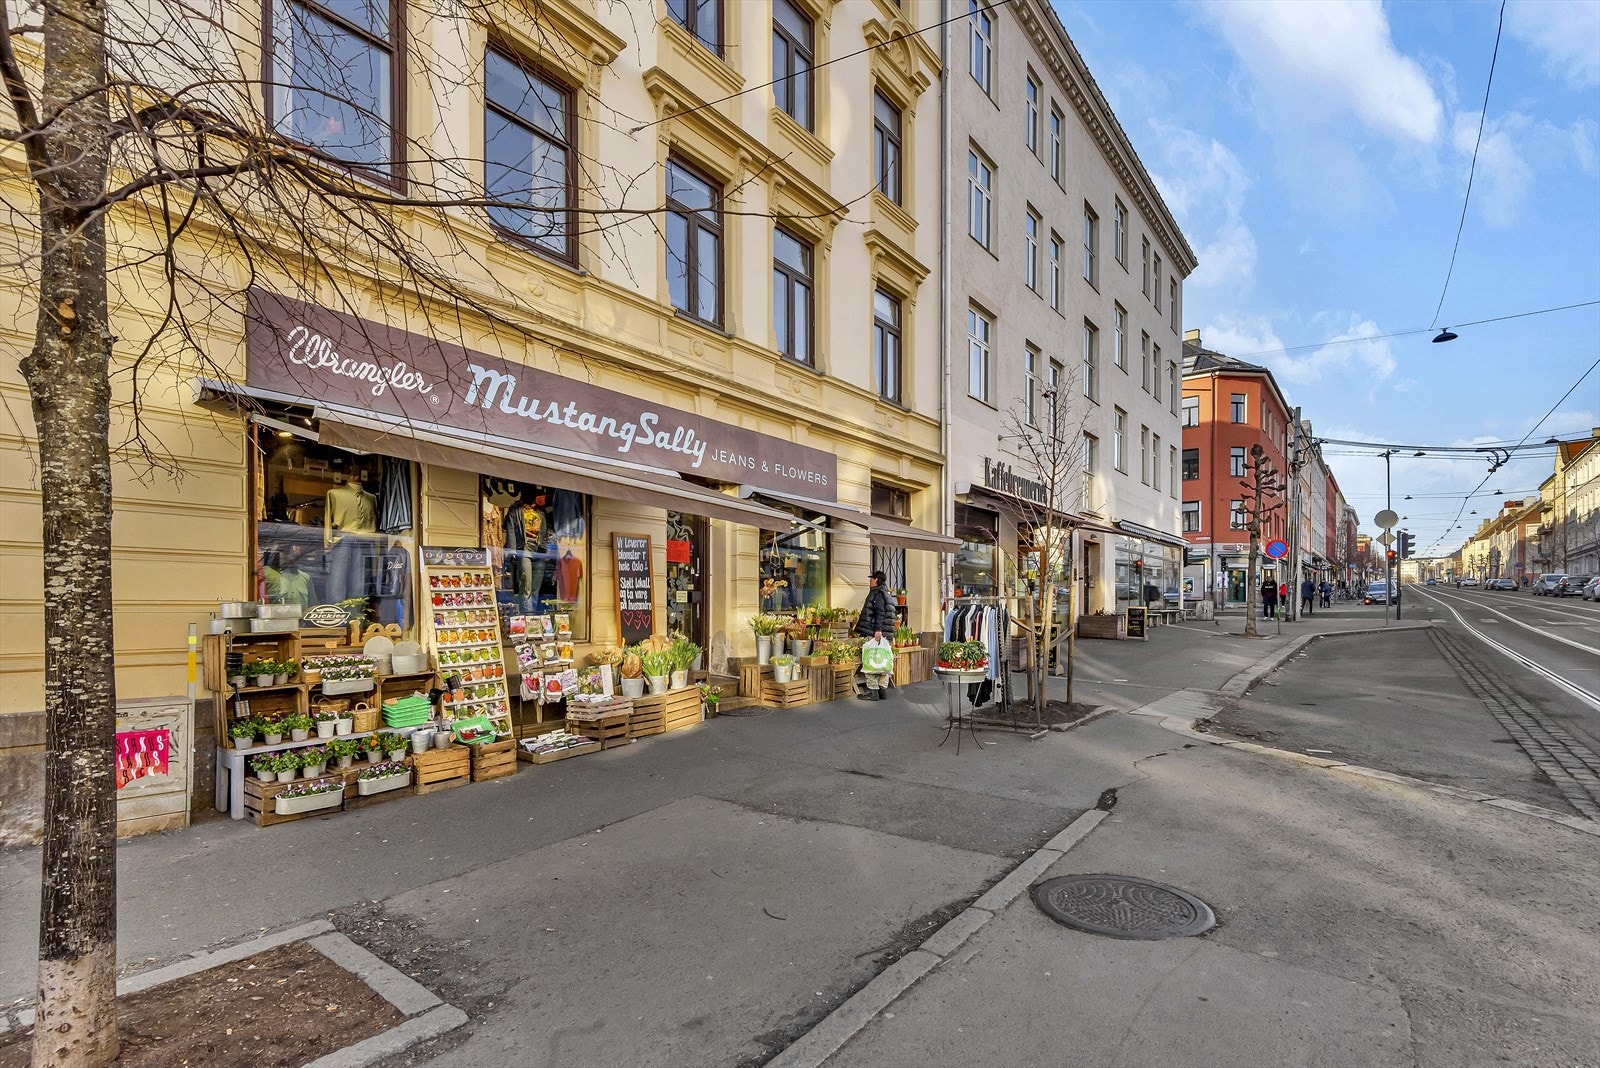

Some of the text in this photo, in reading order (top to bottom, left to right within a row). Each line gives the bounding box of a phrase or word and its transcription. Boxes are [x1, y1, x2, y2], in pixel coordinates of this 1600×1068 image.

[287, 326, 433, 396] Wrangler
[711, 449, 828, 486] JEANS & FLOWERS
[115, 735, 164, 755] SIRKUS
[118, 750, 160, 770] LANDS
